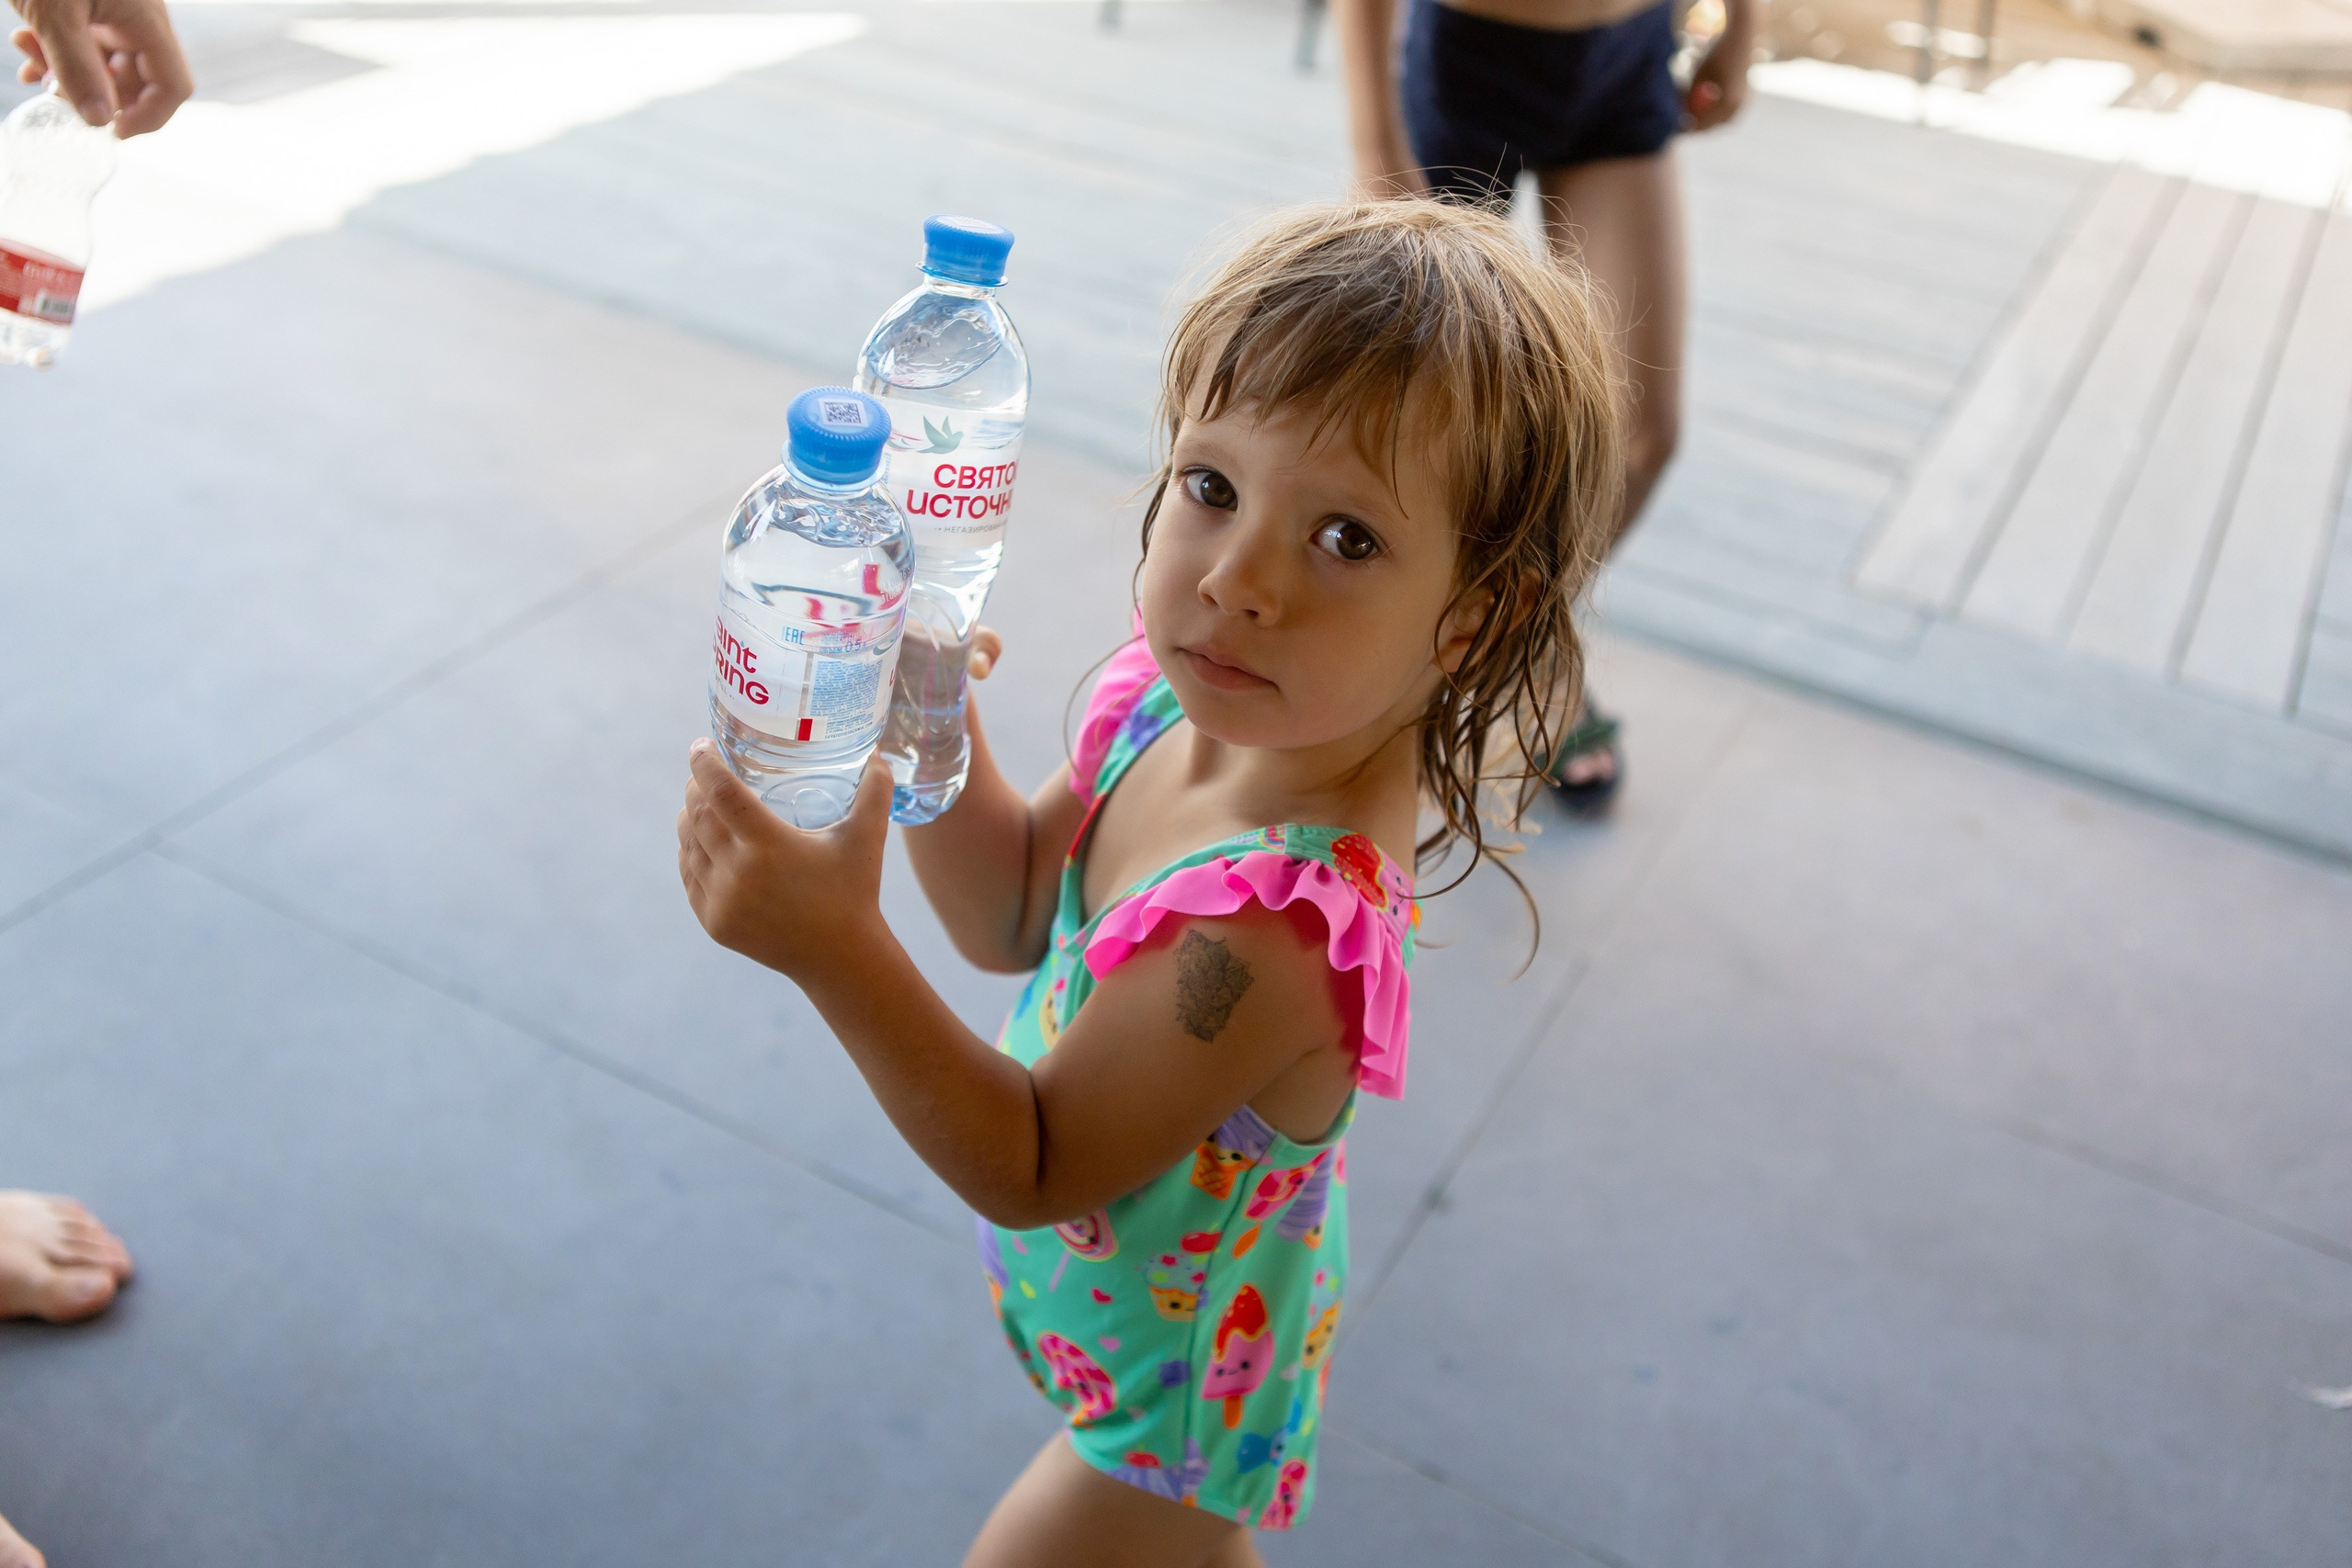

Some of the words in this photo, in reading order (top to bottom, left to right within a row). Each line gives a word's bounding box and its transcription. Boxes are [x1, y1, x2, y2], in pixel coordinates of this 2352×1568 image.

[933, 461, 1017, 490] СВЯТО
[906, 489, 1013, 519] ИСТОЧН
[716, 615, 757, 673] aint
[713, 634, 769, 705] RING
